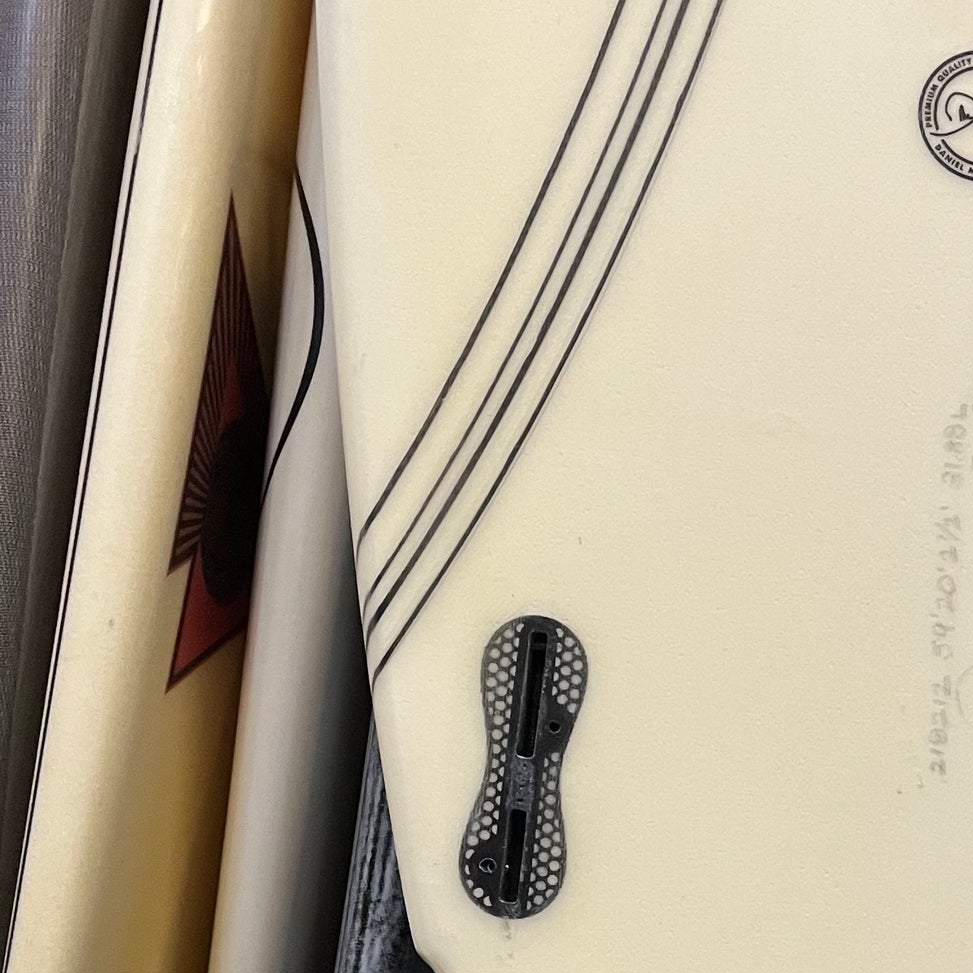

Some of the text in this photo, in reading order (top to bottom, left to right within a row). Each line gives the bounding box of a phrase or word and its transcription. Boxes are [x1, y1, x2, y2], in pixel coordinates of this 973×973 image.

[925, 83, 939, 128] PREMIUM
[937, 58, 972, 82] QUALITY
[934, 143, 964, 171] DANIEL
